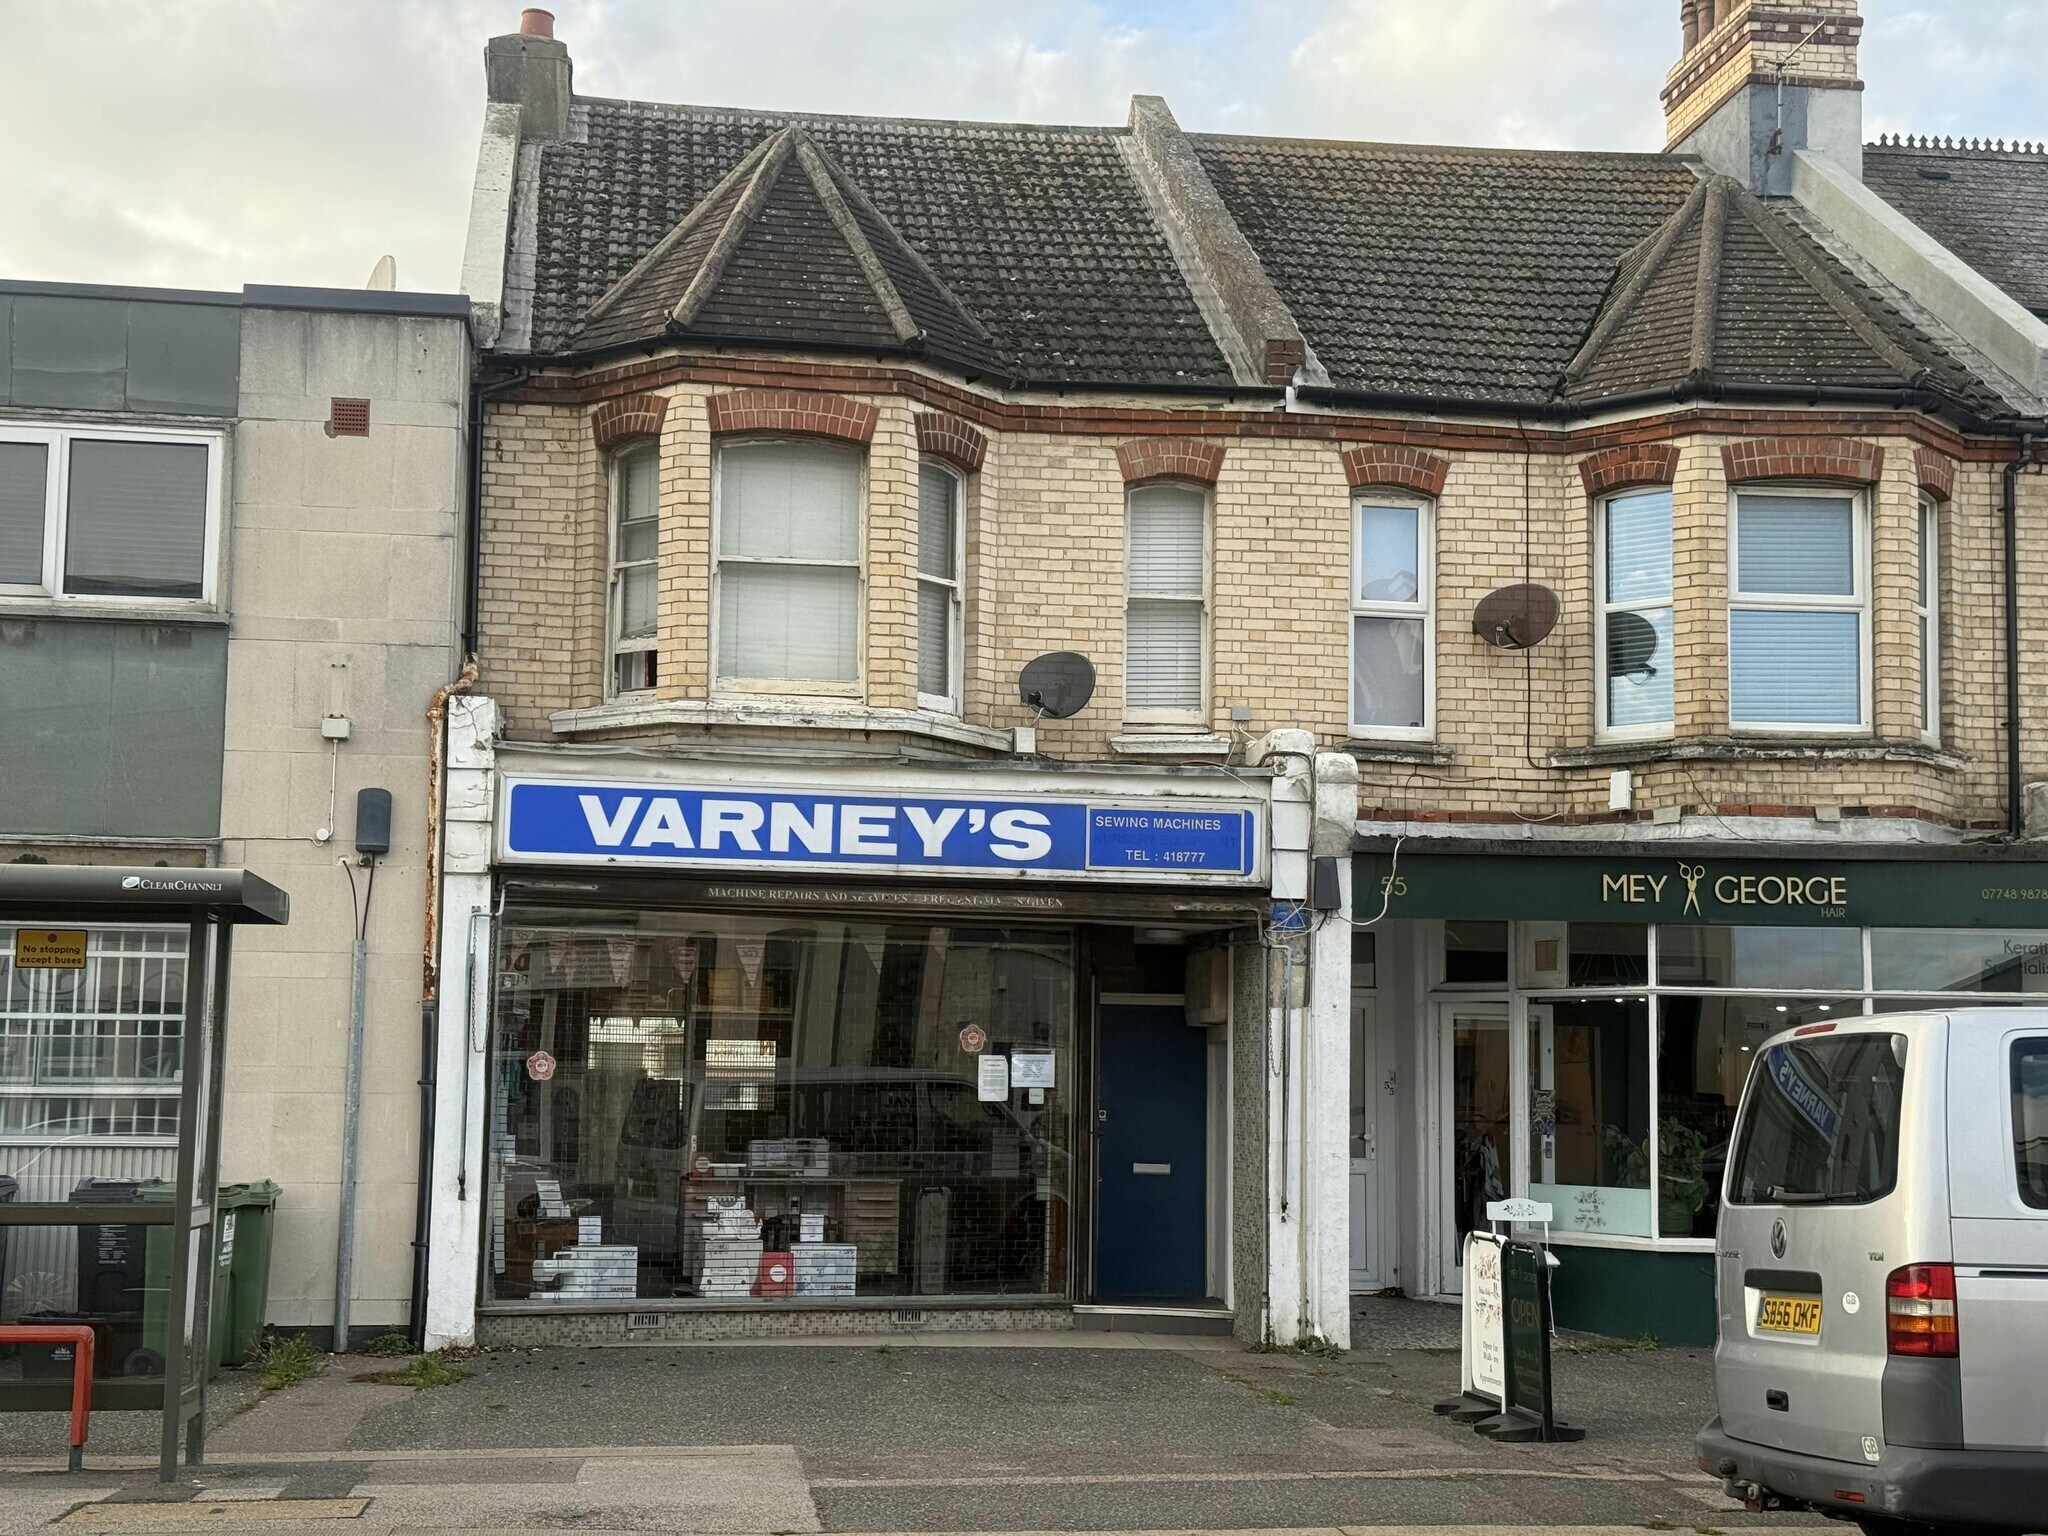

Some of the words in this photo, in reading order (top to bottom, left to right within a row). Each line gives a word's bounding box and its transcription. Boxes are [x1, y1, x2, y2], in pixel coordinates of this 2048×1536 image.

[577, 794, 1053, 862] VARNEY'S
[1095, 815, 1148, 828] SEWING
[1153, 817, 1221, 831] MACHINES
[1125, 849, 1150, 861] TEL
[1162, 851, 1206, 863] 418777
[708, 887, 766, 898] MACHINE
[769, 889, 819, 901] REPAIRS
[822, 892, 848, 901] AND
[1602, 873, 1668, 903] MEY
[1714, 875, 1847, 905] GEORGE
[1981, 888, 2018, 900] 07748
[1821, 907, 1846, 918] HAIR
[23, 945, 37, 953] No
[39, 946, 81, 955] stopping
[20, 956, 52, 965] except
[54, 956, 82, 965] buses
[1845, 1294, 1857, 1305] GB
[1511, 1296, 1540, 1329] OPEN
[1762, 1300, 1792, 1326] SB56
[1792, 1302, 1820, 1329] OKF
[1863, 1437, 1878, 1454] GB
